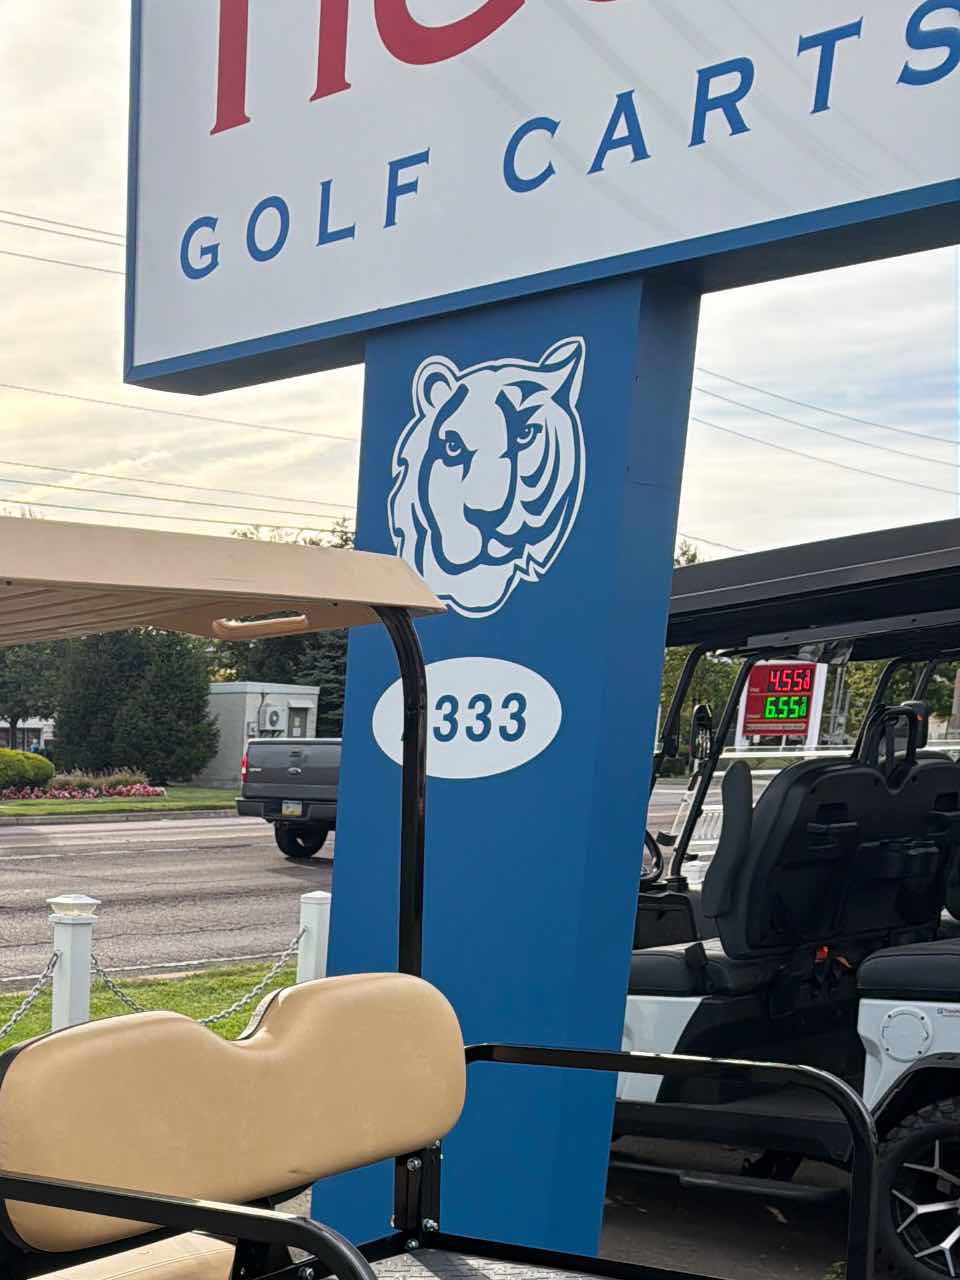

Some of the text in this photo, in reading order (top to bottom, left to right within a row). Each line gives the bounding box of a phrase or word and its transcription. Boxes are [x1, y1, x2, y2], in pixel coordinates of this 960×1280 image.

[180, 147, 430, 279] GOLF
[502, 0, 960, 193] CARTS
[401, 692, 528, 742] 333
[765, 696, 800, 718] 6.55
